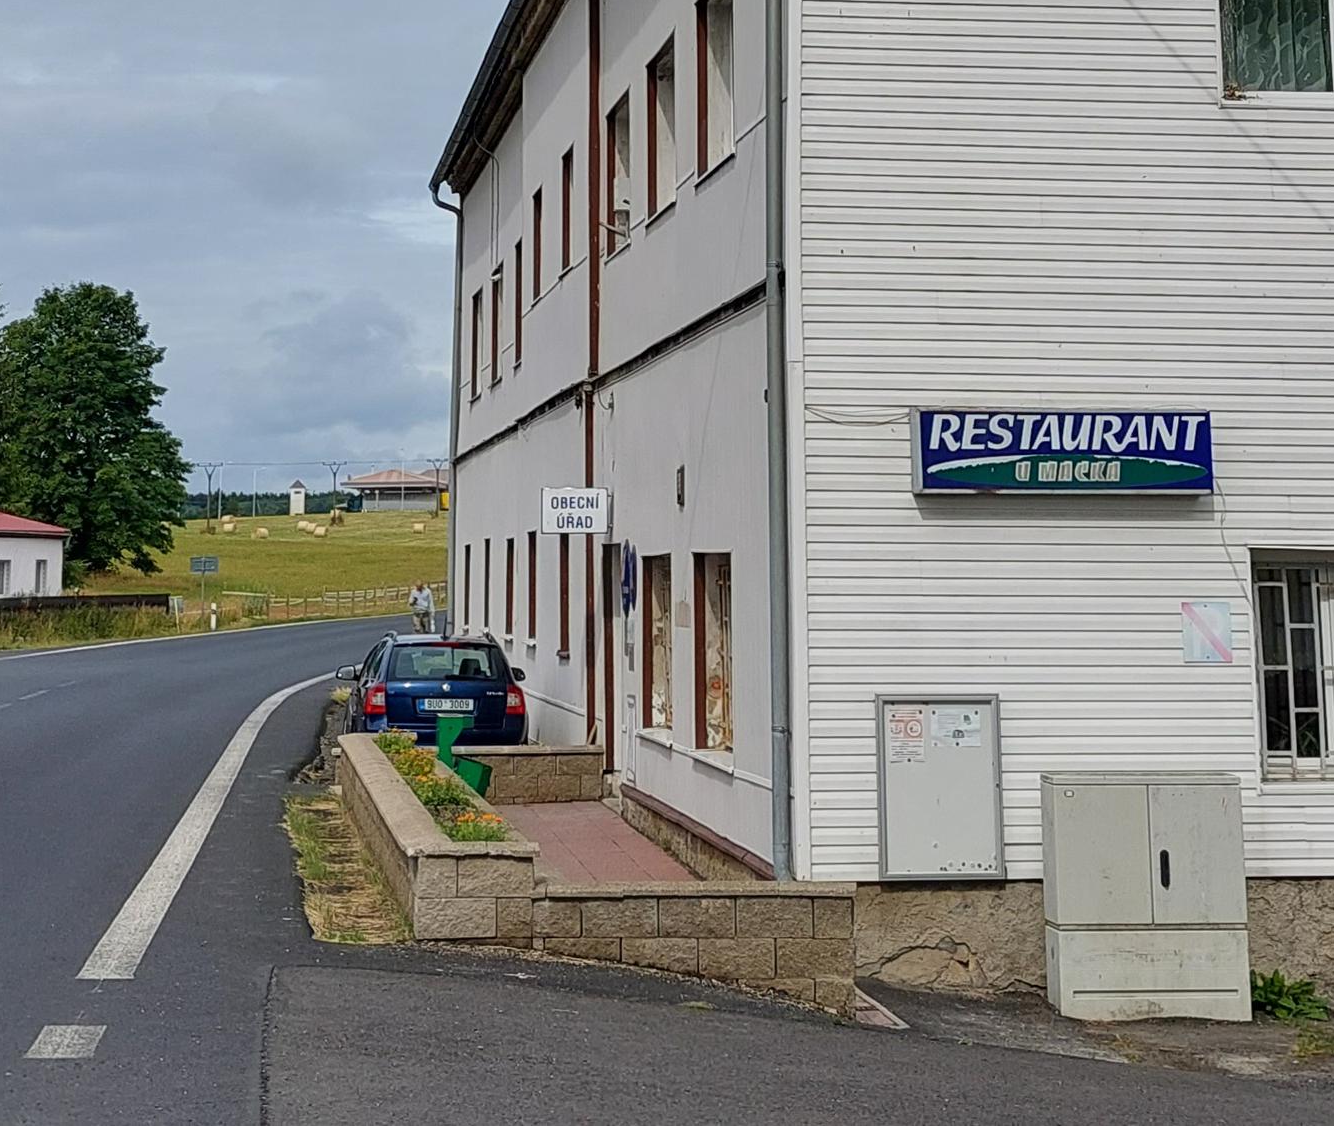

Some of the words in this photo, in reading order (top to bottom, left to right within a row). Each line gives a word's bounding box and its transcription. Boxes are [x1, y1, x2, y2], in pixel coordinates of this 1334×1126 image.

[928, 414, 1206, 453] RESTAURANT
[1015, 461, 1031, 482] U
[550, 492, 600, 510] OBECNÍ
[556, 512, 594, 529] ÚŘAD
